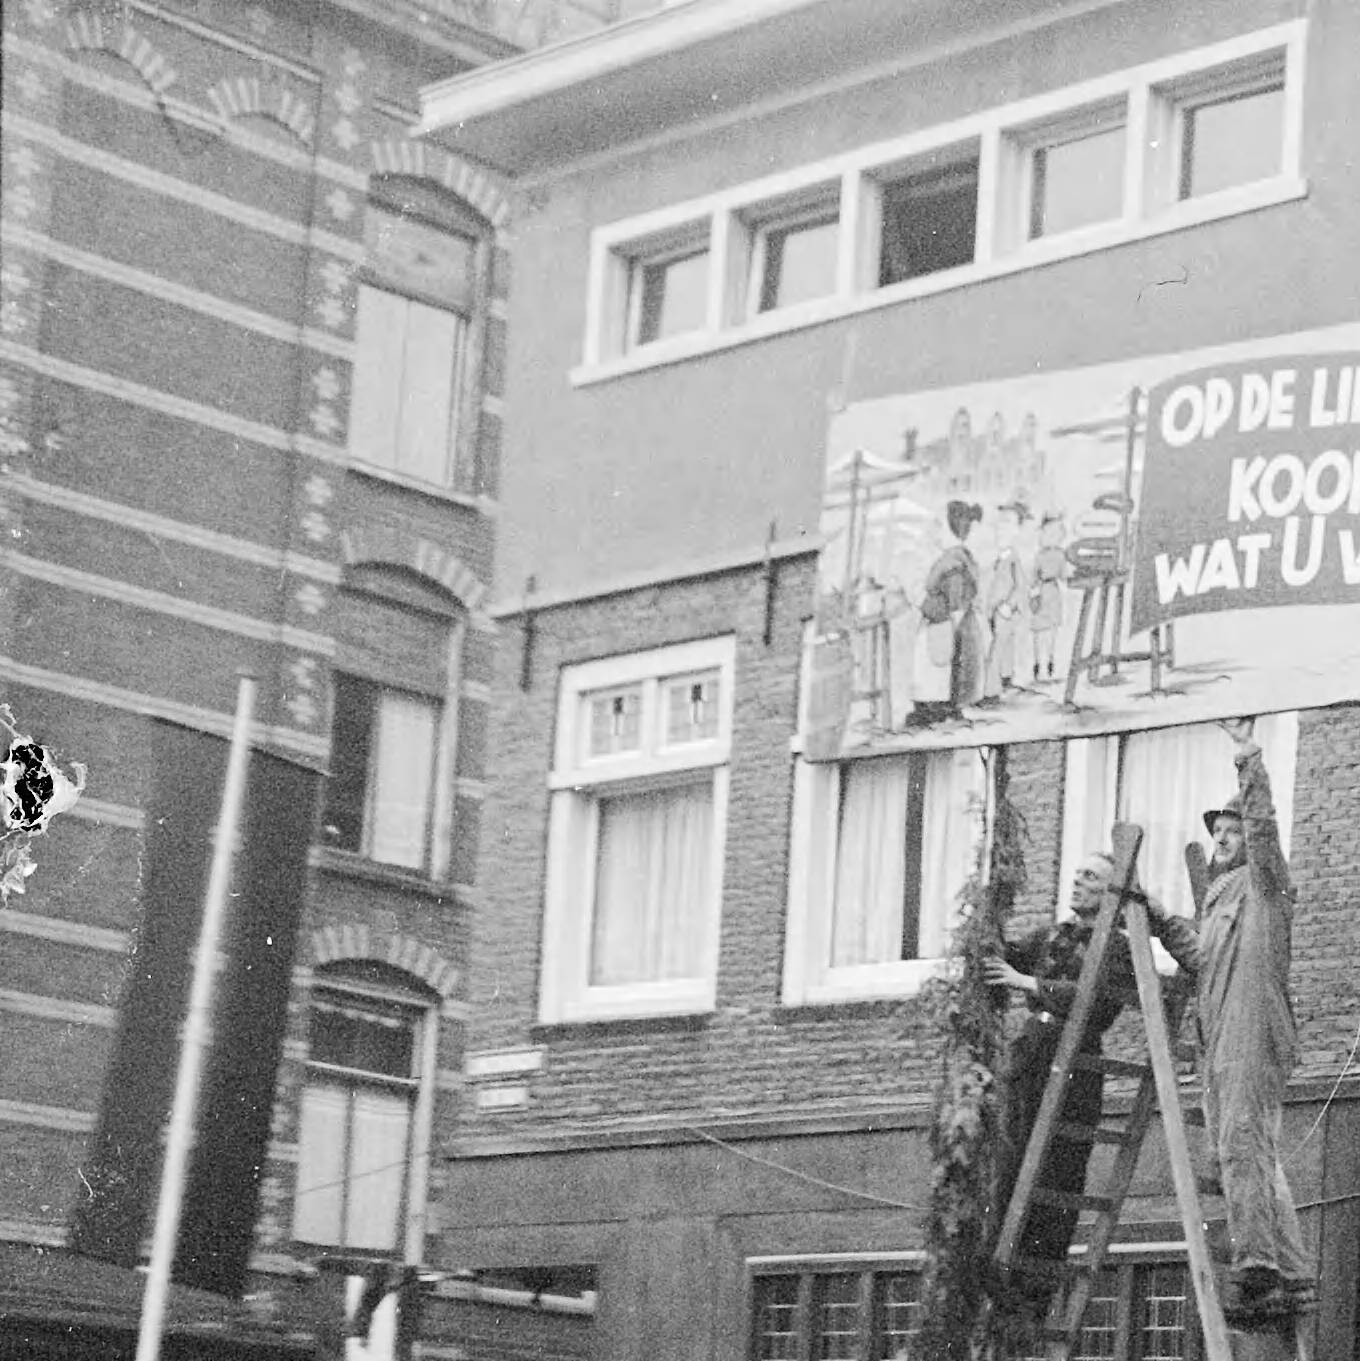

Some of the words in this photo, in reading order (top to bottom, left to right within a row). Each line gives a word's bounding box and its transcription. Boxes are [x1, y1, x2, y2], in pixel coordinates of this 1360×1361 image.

[1160, 376, 1233, 447] OP
[1237, 369, 1296, 433] DE
[1154, 532, 1272, 605] WAT
[1280, 515, 1326, 587] U
